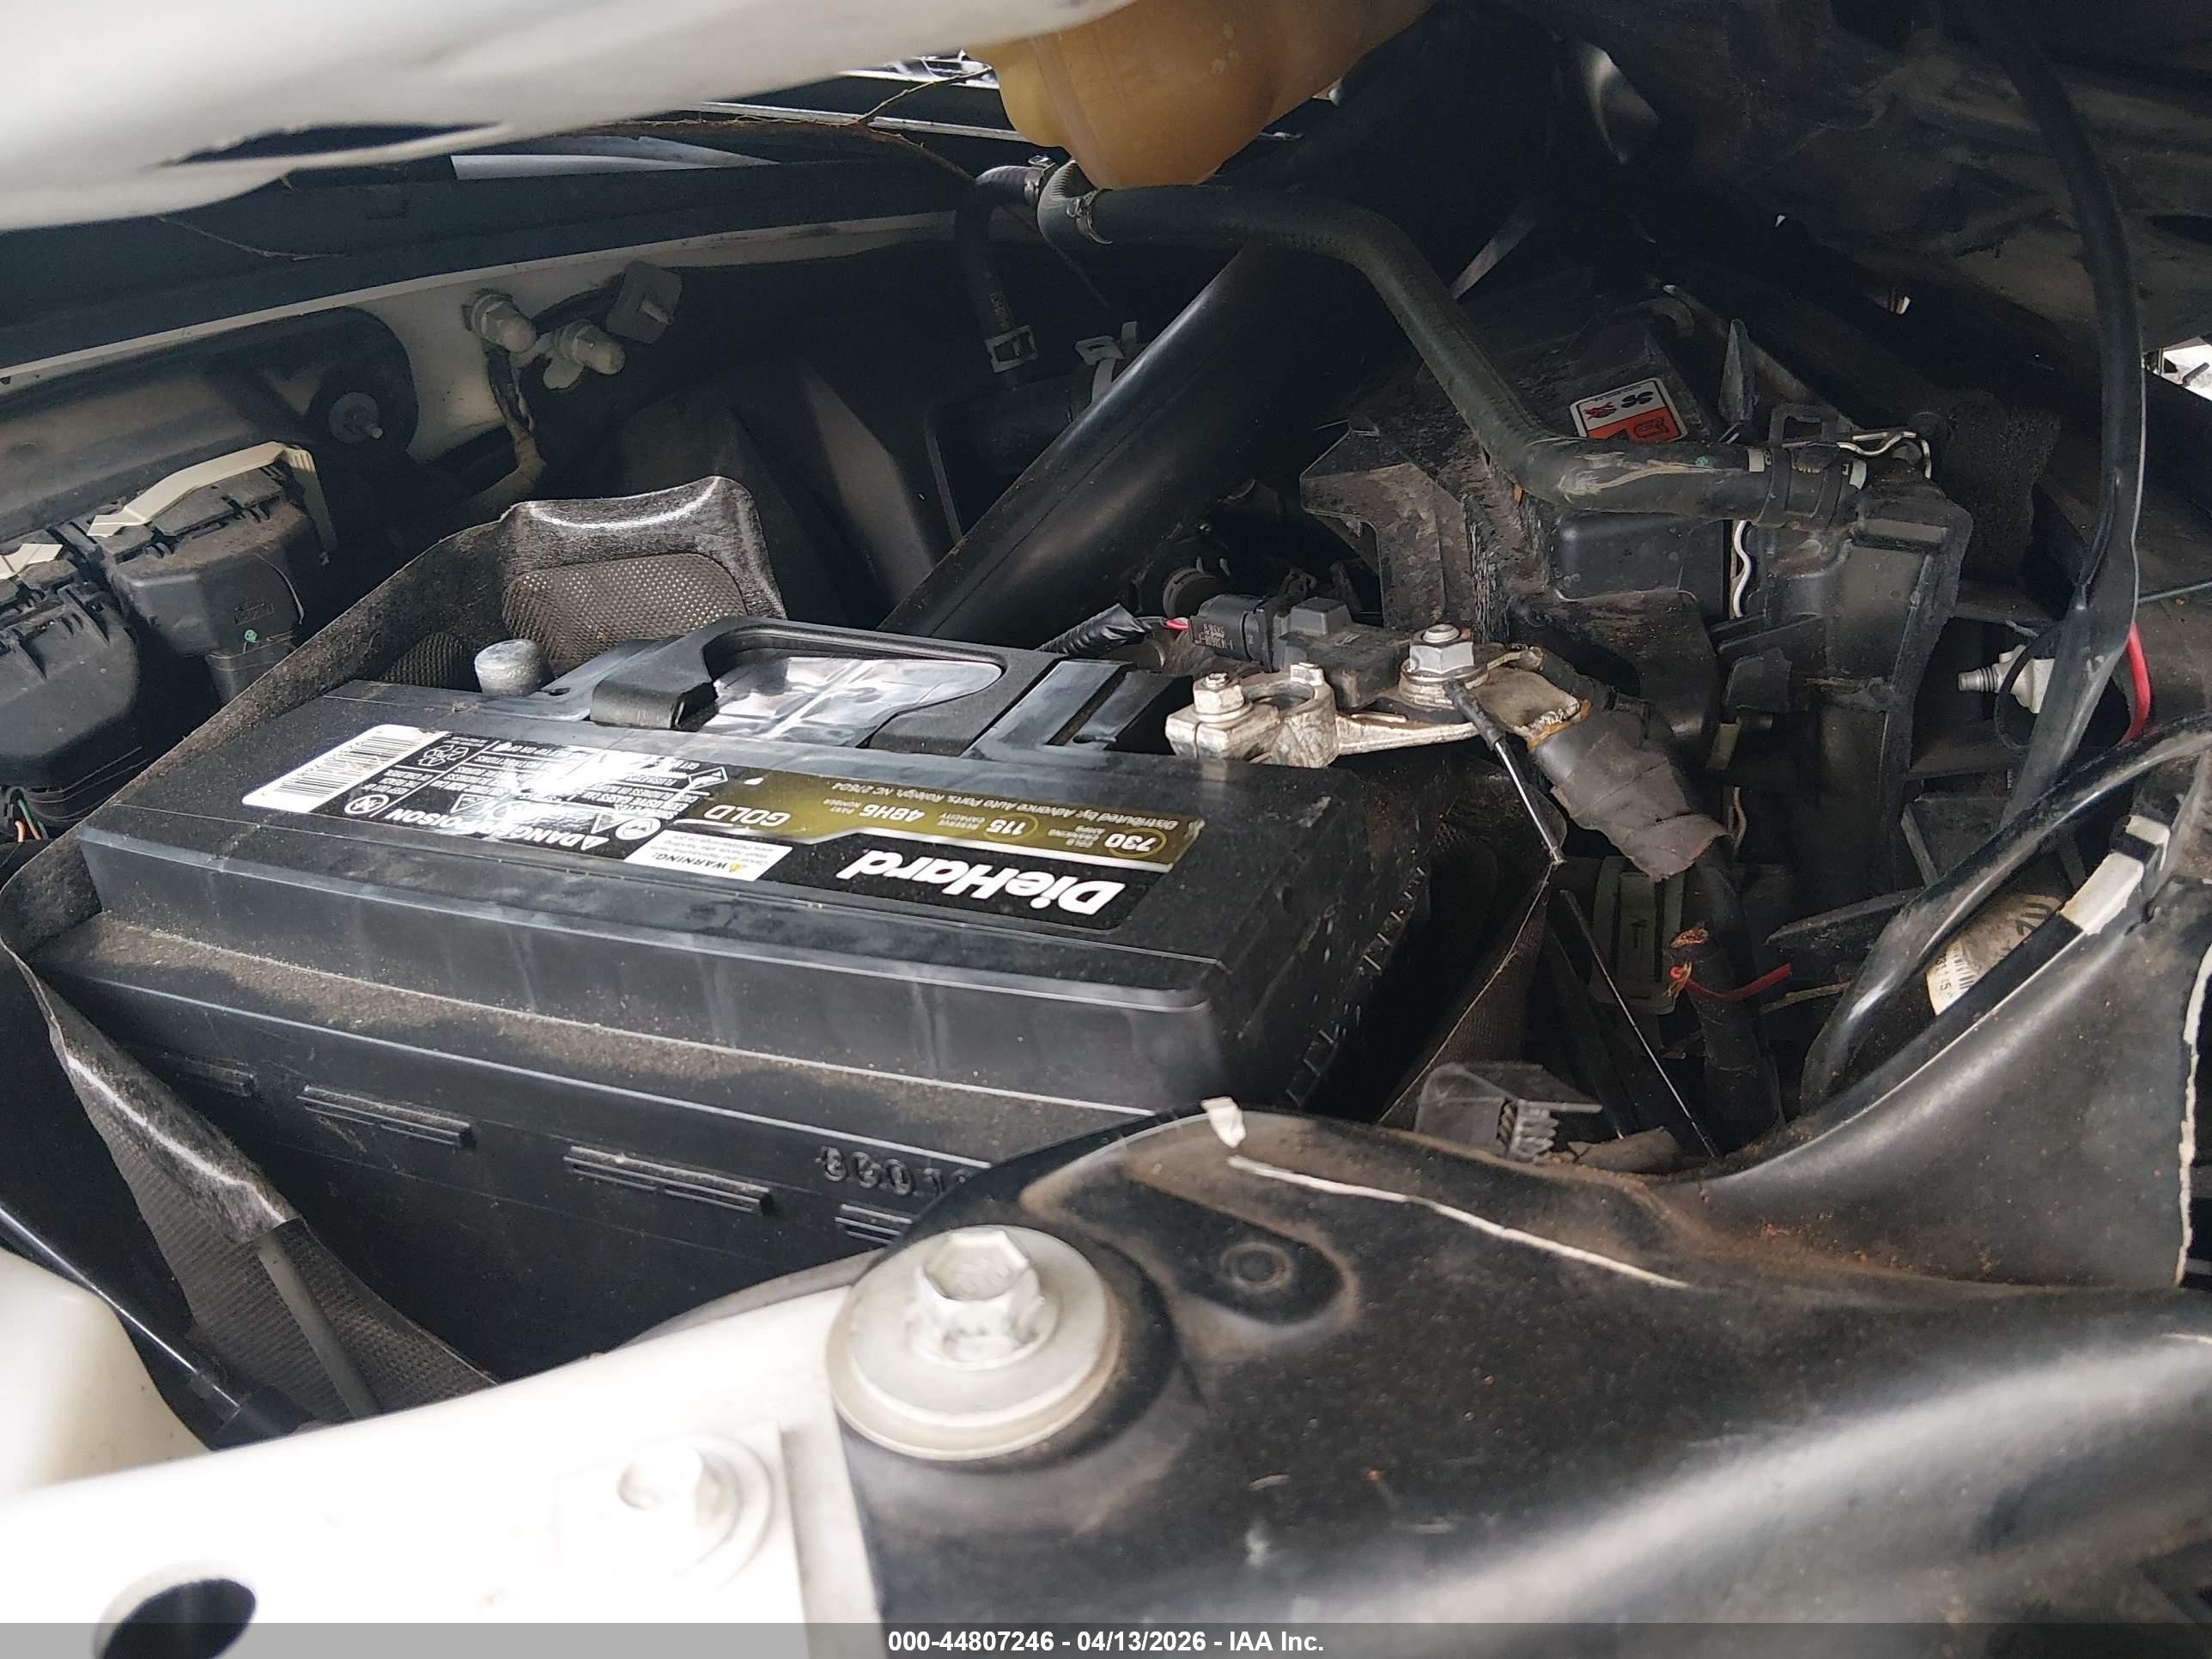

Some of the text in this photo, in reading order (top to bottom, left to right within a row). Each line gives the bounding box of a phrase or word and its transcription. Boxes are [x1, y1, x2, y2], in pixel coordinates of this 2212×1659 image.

[860, 805, 925, 823] 48H6
[985, 800, 1016, 811] Auto
[1018, 804, 1074, 817] Advance
[703, 805, 791, 827] GOLD
[1099, 812, 1177, 830] Distributed
[988, 819, 1028, 836] 115
[1105, 834, 1156, 852] 730
[652, 854, 727, 868] WARNING:
[836, 849, 1126, 915] DieHard
